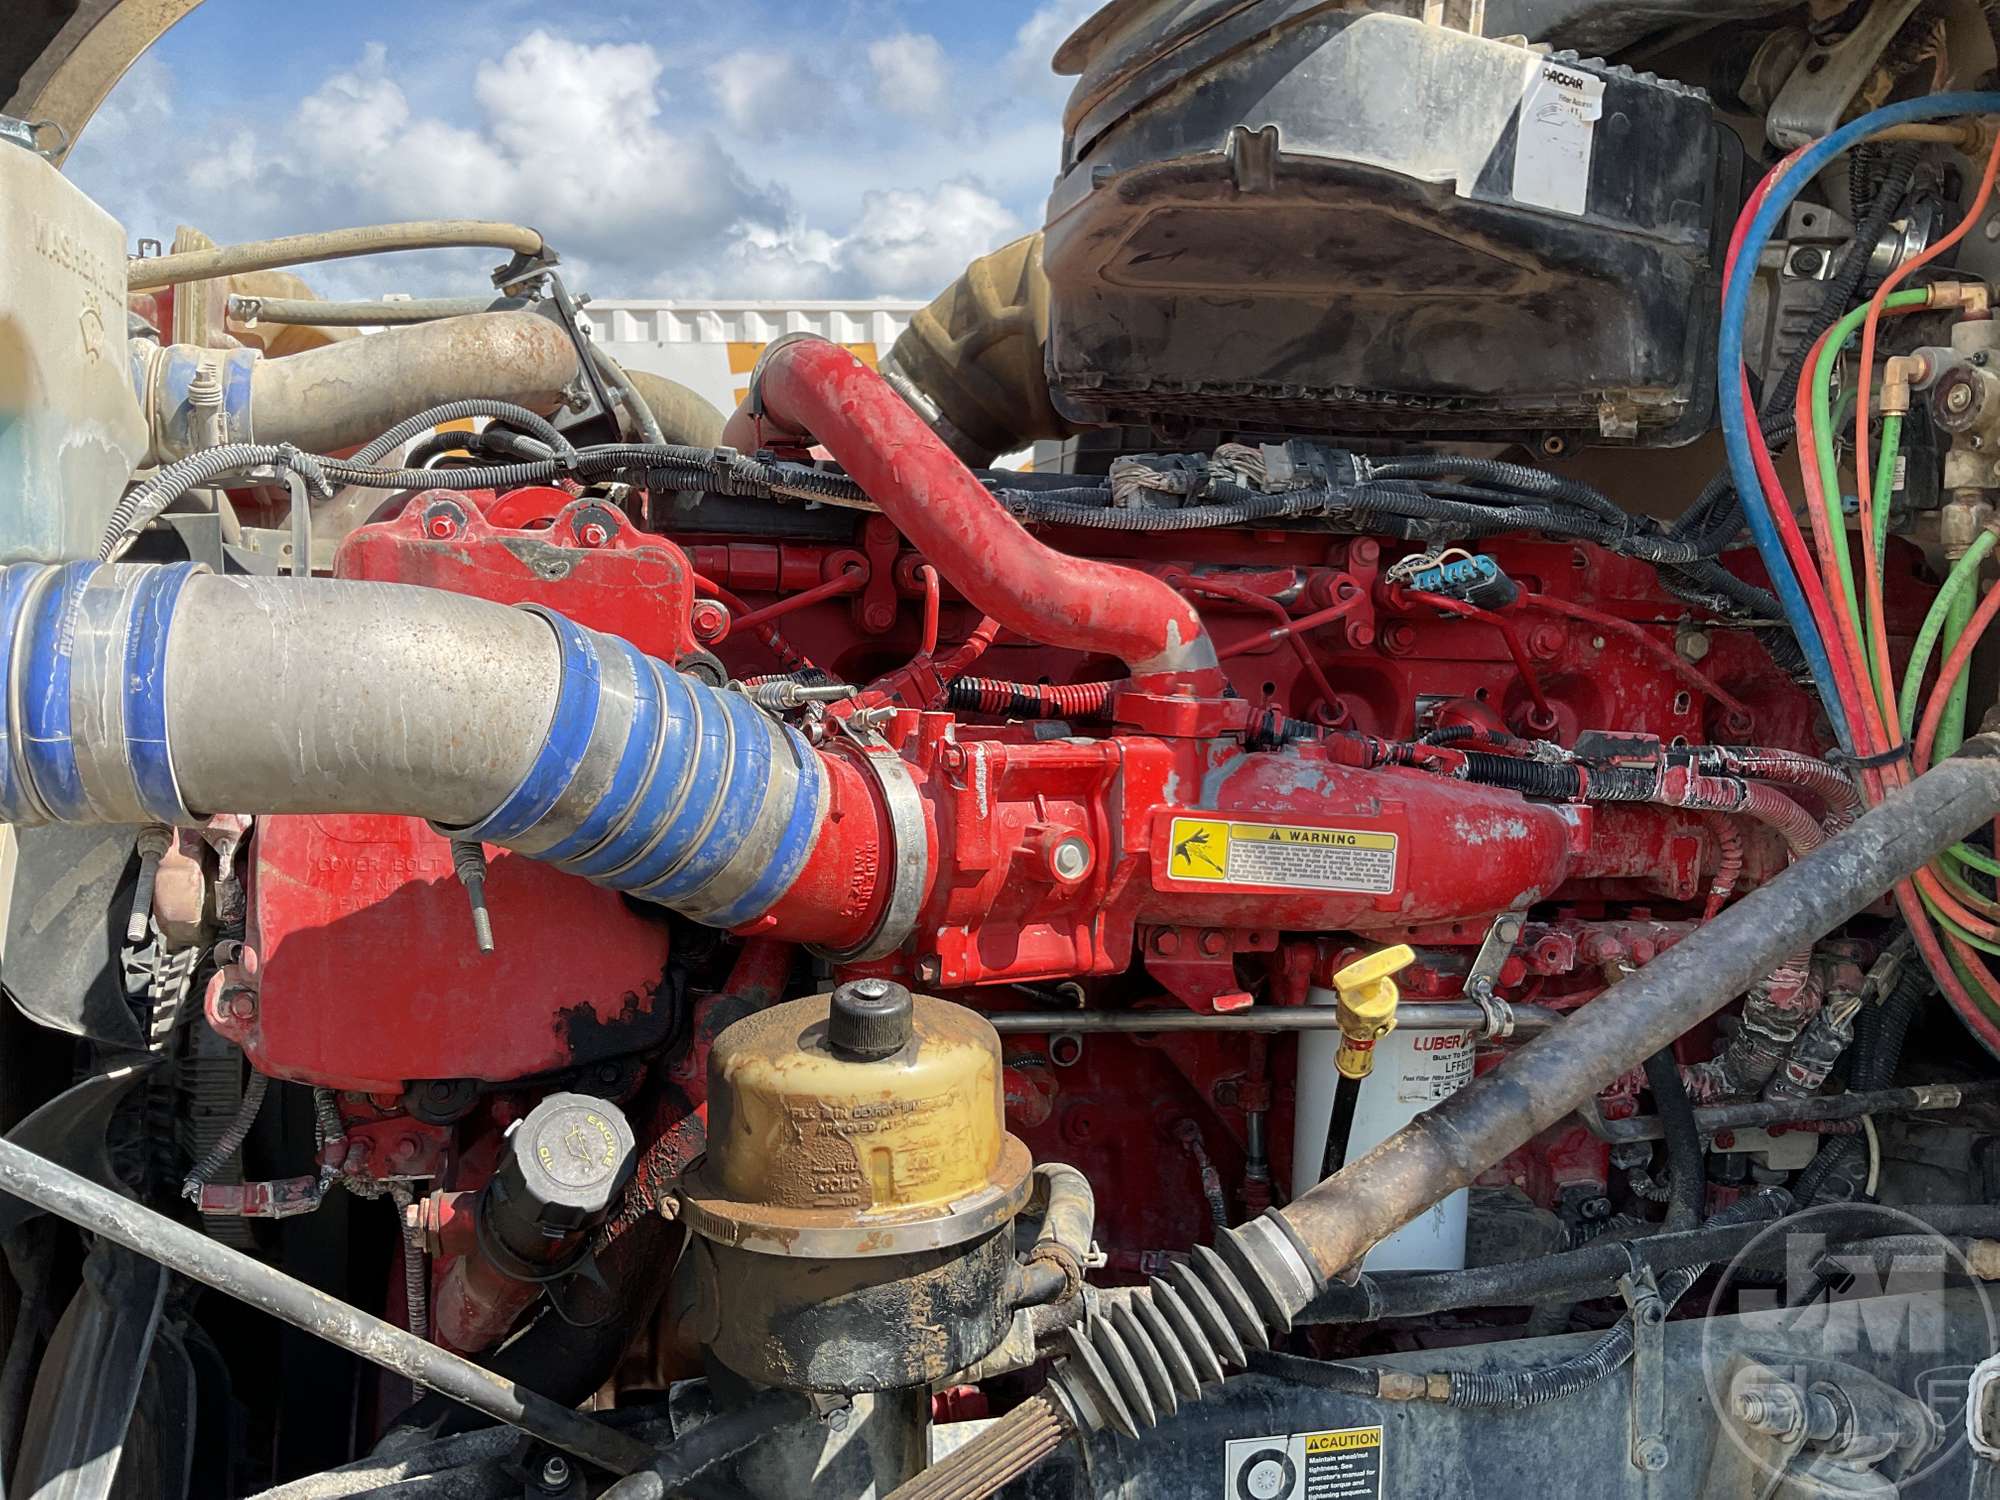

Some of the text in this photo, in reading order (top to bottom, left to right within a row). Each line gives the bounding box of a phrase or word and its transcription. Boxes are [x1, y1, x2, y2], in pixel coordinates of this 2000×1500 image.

[1543, 68, 1583, 90] PACCAR
[1290, 831, 1356, 845] WARNING
[587, 1114, 617, 1167] ENGINE
[540, 1147, 553, 1170] OIL
[1320, 1433, 1379, 1449] CAUTION
